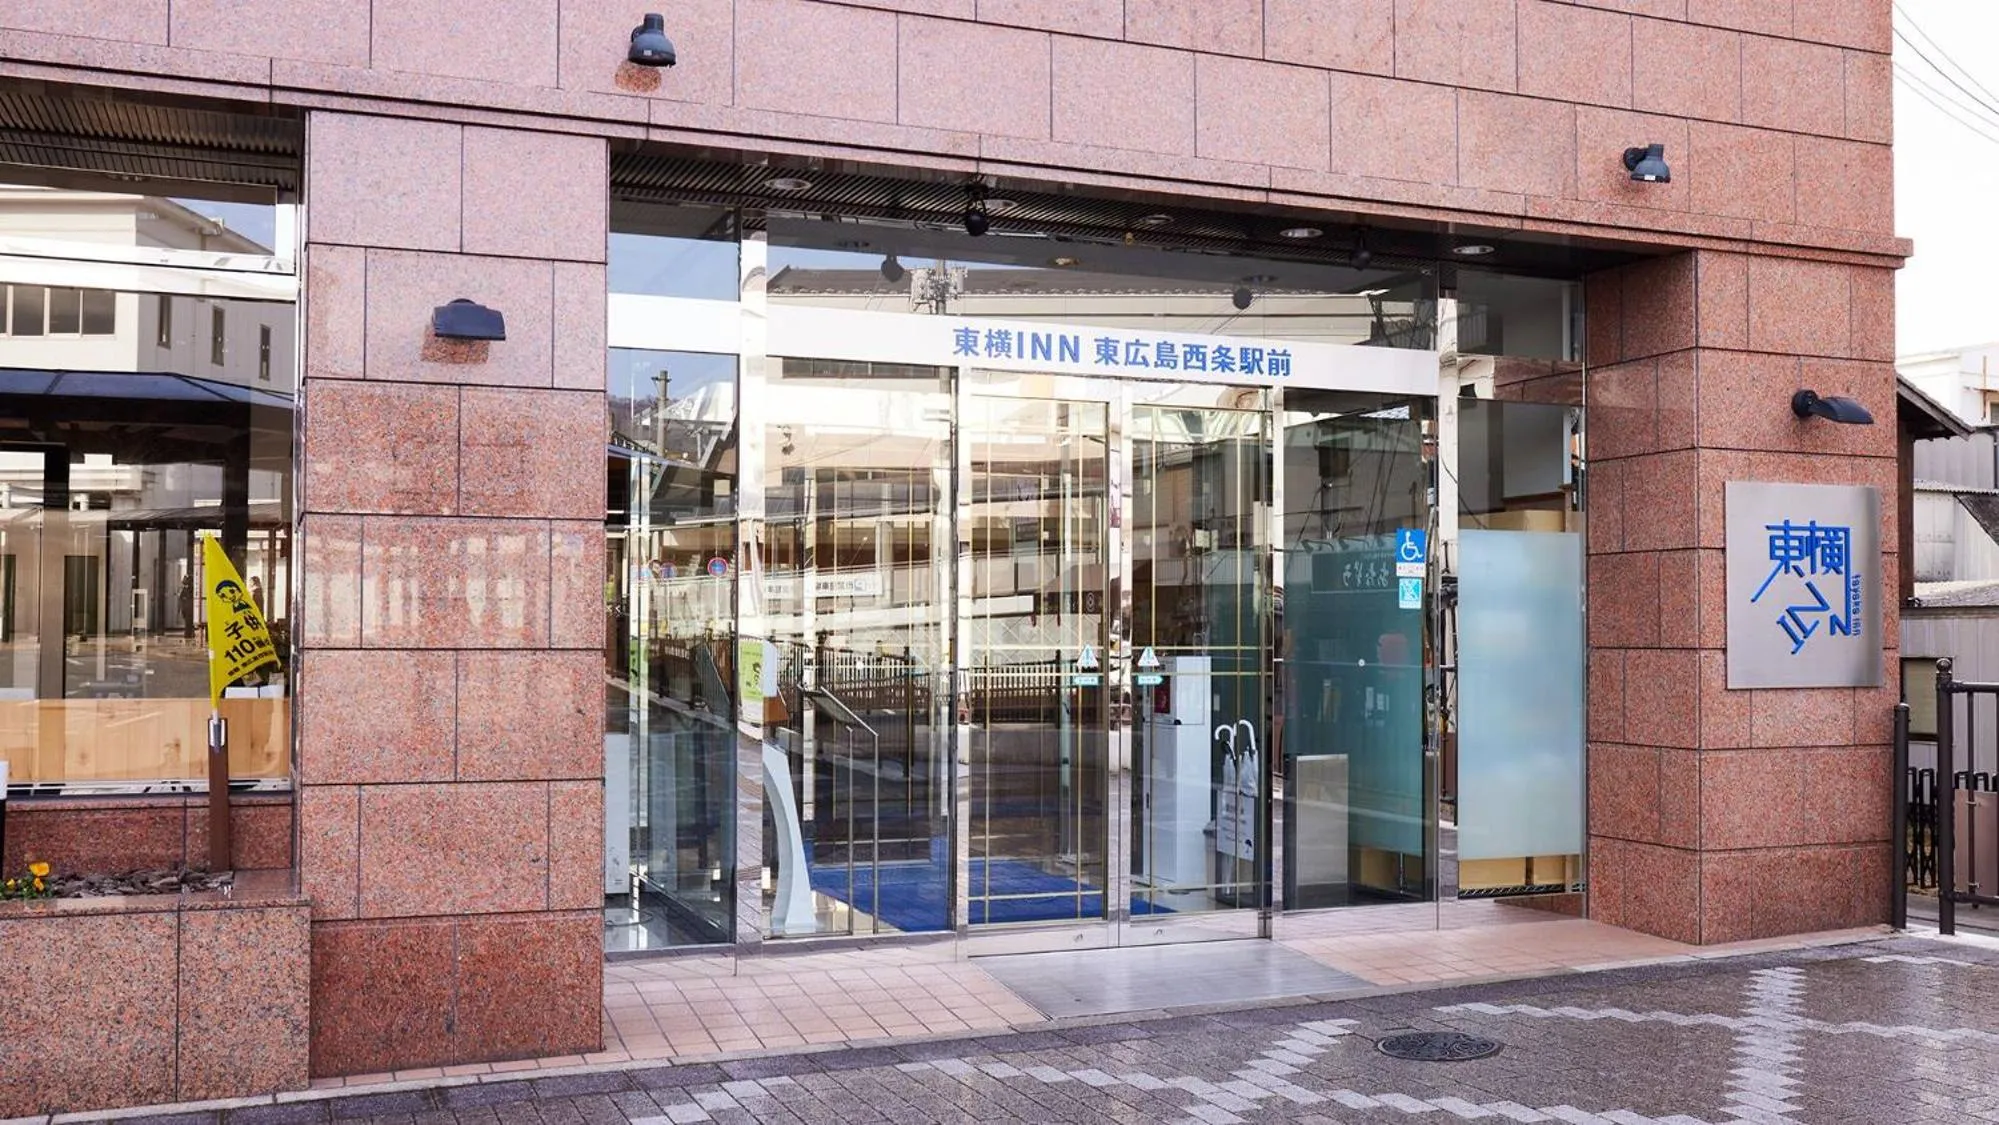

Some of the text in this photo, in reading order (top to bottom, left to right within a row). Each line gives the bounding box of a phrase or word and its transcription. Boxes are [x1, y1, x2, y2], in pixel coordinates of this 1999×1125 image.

[953, 327, 1292, 376] 東横INN 東広島西条駅前
